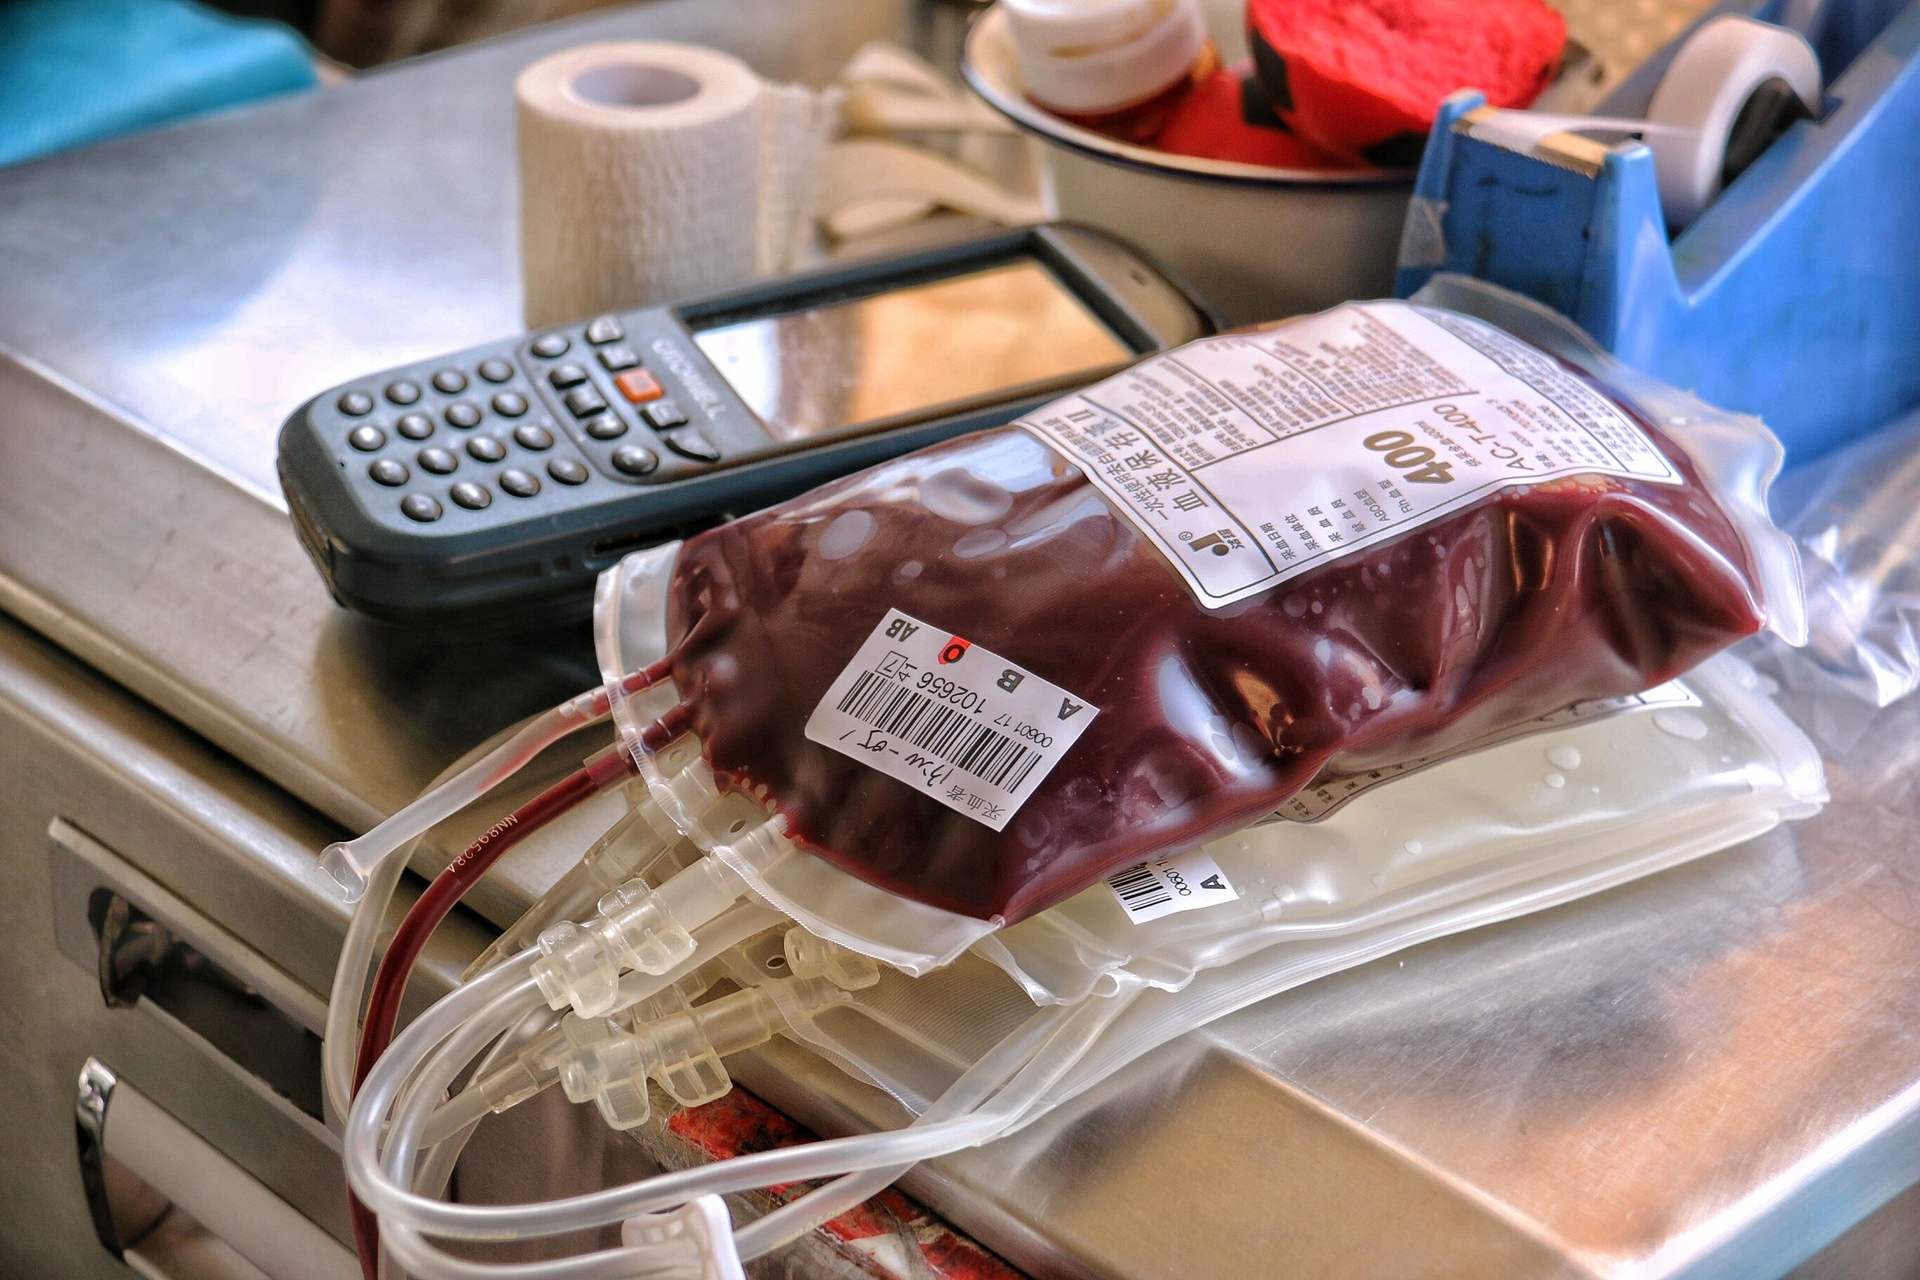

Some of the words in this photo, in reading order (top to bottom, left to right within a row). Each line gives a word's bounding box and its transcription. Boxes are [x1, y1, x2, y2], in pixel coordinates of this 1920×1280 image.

[1434, 404, 1535, 472] AC-T-400
[1362, 431, 1455, 485] 400
[1353, 488, 1391, 522] ABO血型
[1259, 522, 1297, 561] 采血日期
[1284, 512, 1321, 551] 采血单位
[885, 617, 919, 643] AB
[916, 671, 987, 715] 102656
[996, 668, 1025, 694] B
[1057, 697, 1083, 721] A
[946, 784, 1006, 821] 采血者
[1200, 873, 1227, 890] A
